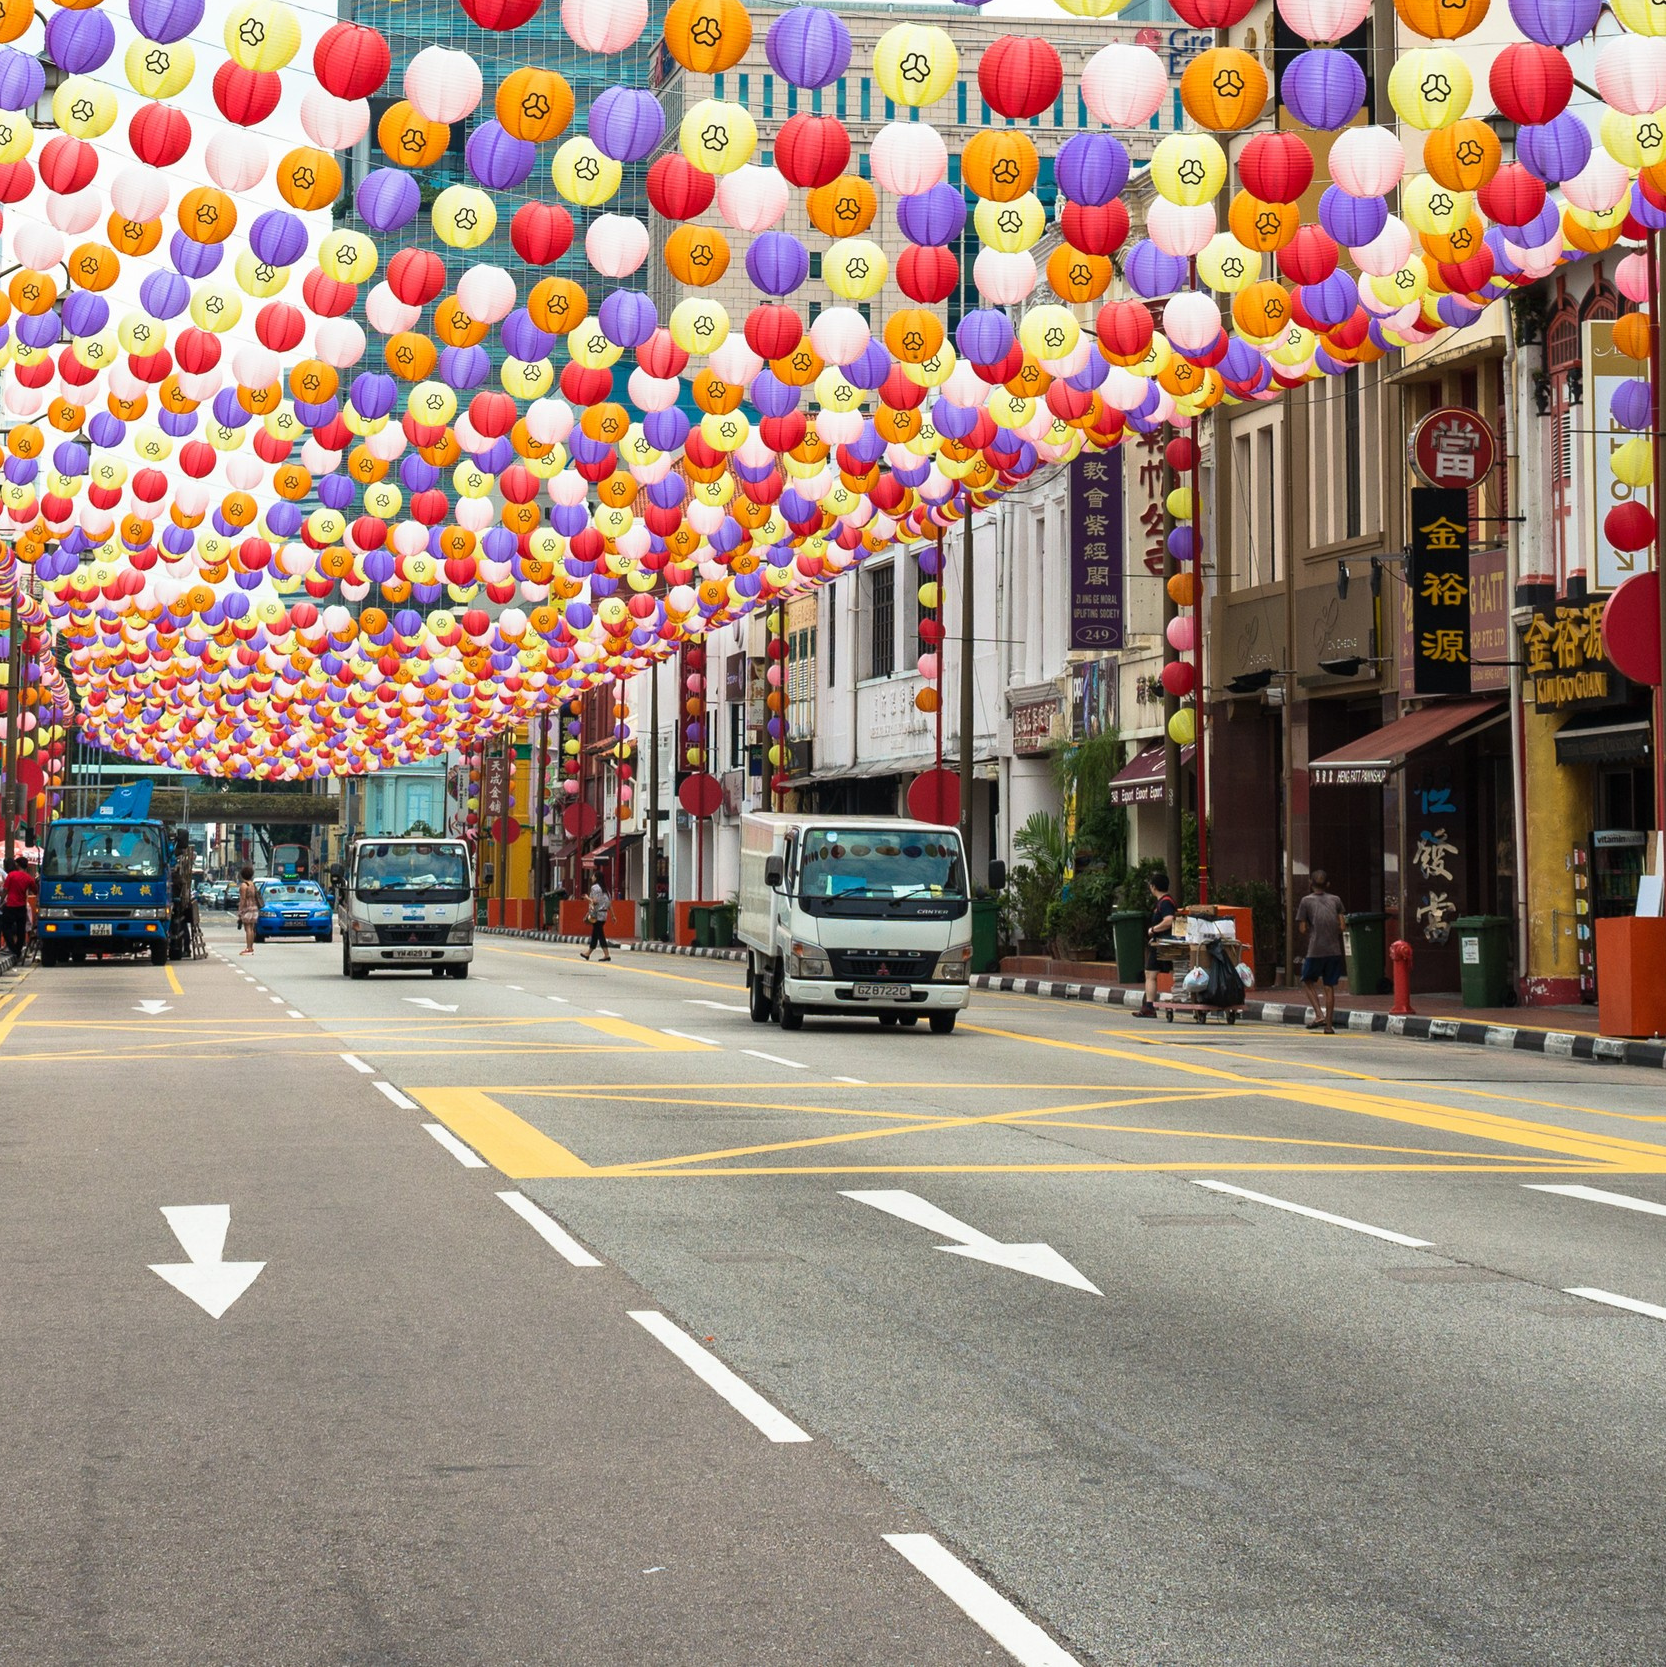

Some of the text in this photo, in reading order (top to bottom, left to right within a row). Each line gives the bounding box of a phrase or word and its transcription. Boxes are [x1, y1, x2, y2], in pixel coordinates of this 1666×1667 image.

[1430, 419, 1480, 480] 當
[1082, 452, 1109, 587] 教會紫經閣
[1419, 516, 1469, 662] 金裕源
[1480, 571, 1505, 614] FATT
[1085, 629, 1109, 640] 249
[1524, 600, 1608, 674] 金裕源
[847, 949, 921, 957] FUSO
[857, 986, 906, 996] GZ8722C
